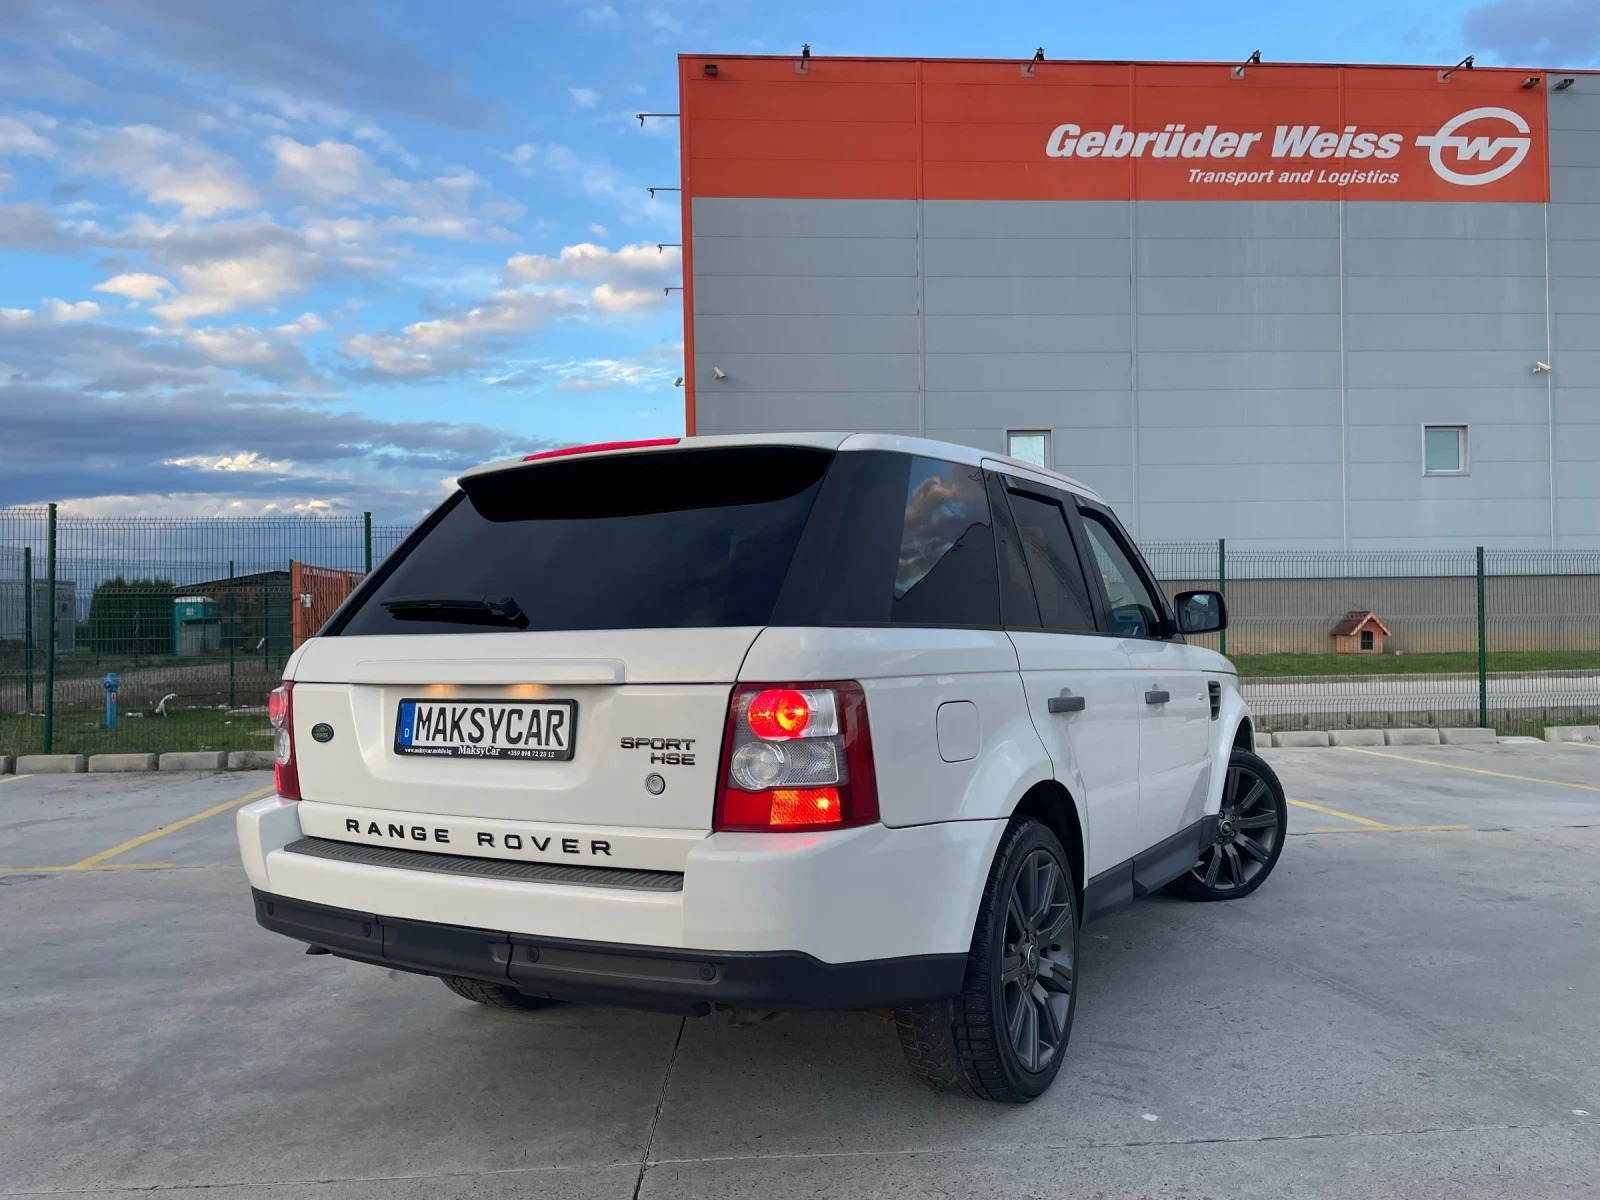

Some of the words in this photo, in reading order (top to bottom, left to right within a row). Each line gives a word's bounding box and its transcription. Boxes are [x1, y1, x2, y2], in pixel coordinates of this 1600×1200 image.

[1045, 124, 1262, 159] Gebrüder
[1271, 125, 1403, 159] Weiss
[1188, 168, 1275, 186] Transport
[1277, 168, 1313, 184] and
[1317, 168, 1399, 187] Logistics
[415, 706, 564, 746] MAKSYCAR
[458, 745, 501, 757] MaksyCar
[620, 737, 696, 751] SPORT
[650, 752, 696, 766] HSE
[345, 818, 451, 844] RANGE
[477, 831, 613, 856] ROVER
